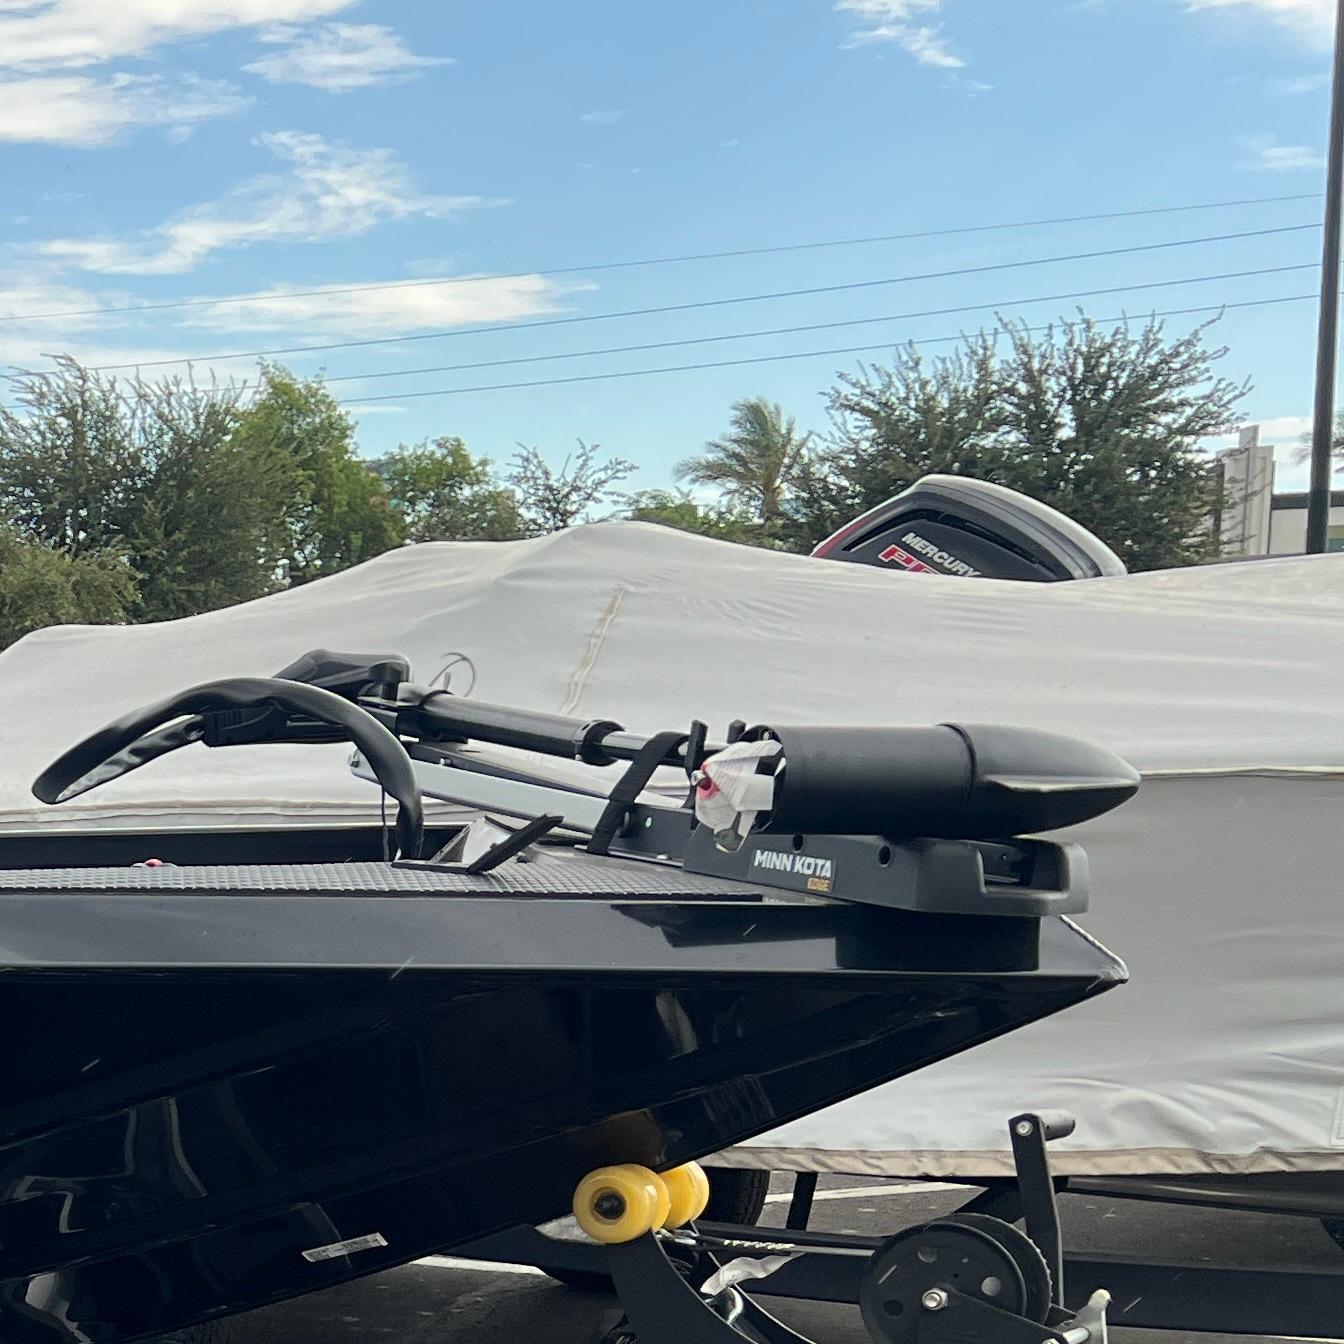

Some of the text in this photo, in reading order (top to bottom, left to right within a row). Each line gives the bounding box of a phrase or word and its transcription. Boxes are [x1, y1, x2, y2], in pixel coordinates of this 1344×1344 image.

[901, 532, 982, 577] MERCURY
[753, 849, 832, 878] MINN KOTA
